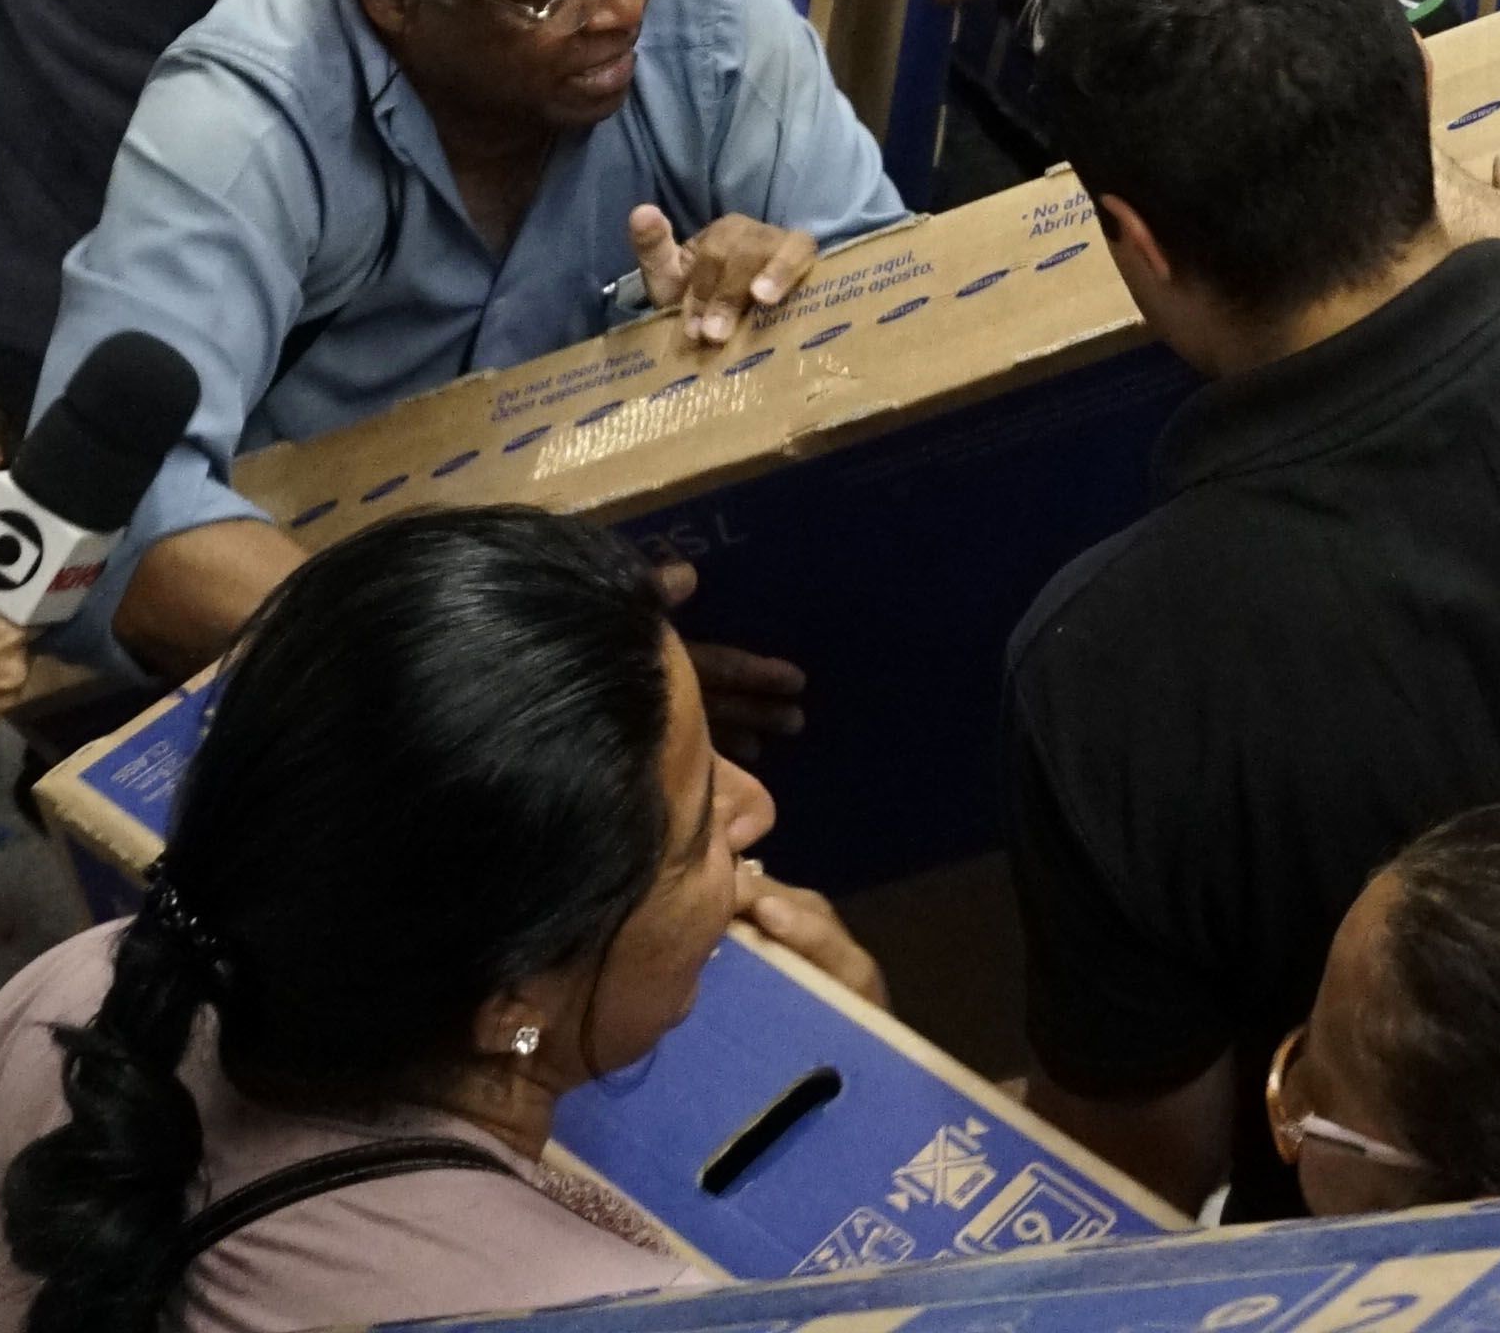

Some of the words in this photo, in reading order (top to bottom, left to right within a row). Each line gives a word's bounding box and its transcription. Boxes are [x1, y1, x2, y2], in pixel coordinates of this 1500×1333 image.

[1028, 212, 1078, 240] Abrir
[796, 301, 821, 319] no
[824, 285, 866, 310] lado
[866, 260, 935, 294] oposto.
[839, 268, 870, 291] por
[871, 249, 916, 275] aqui.
